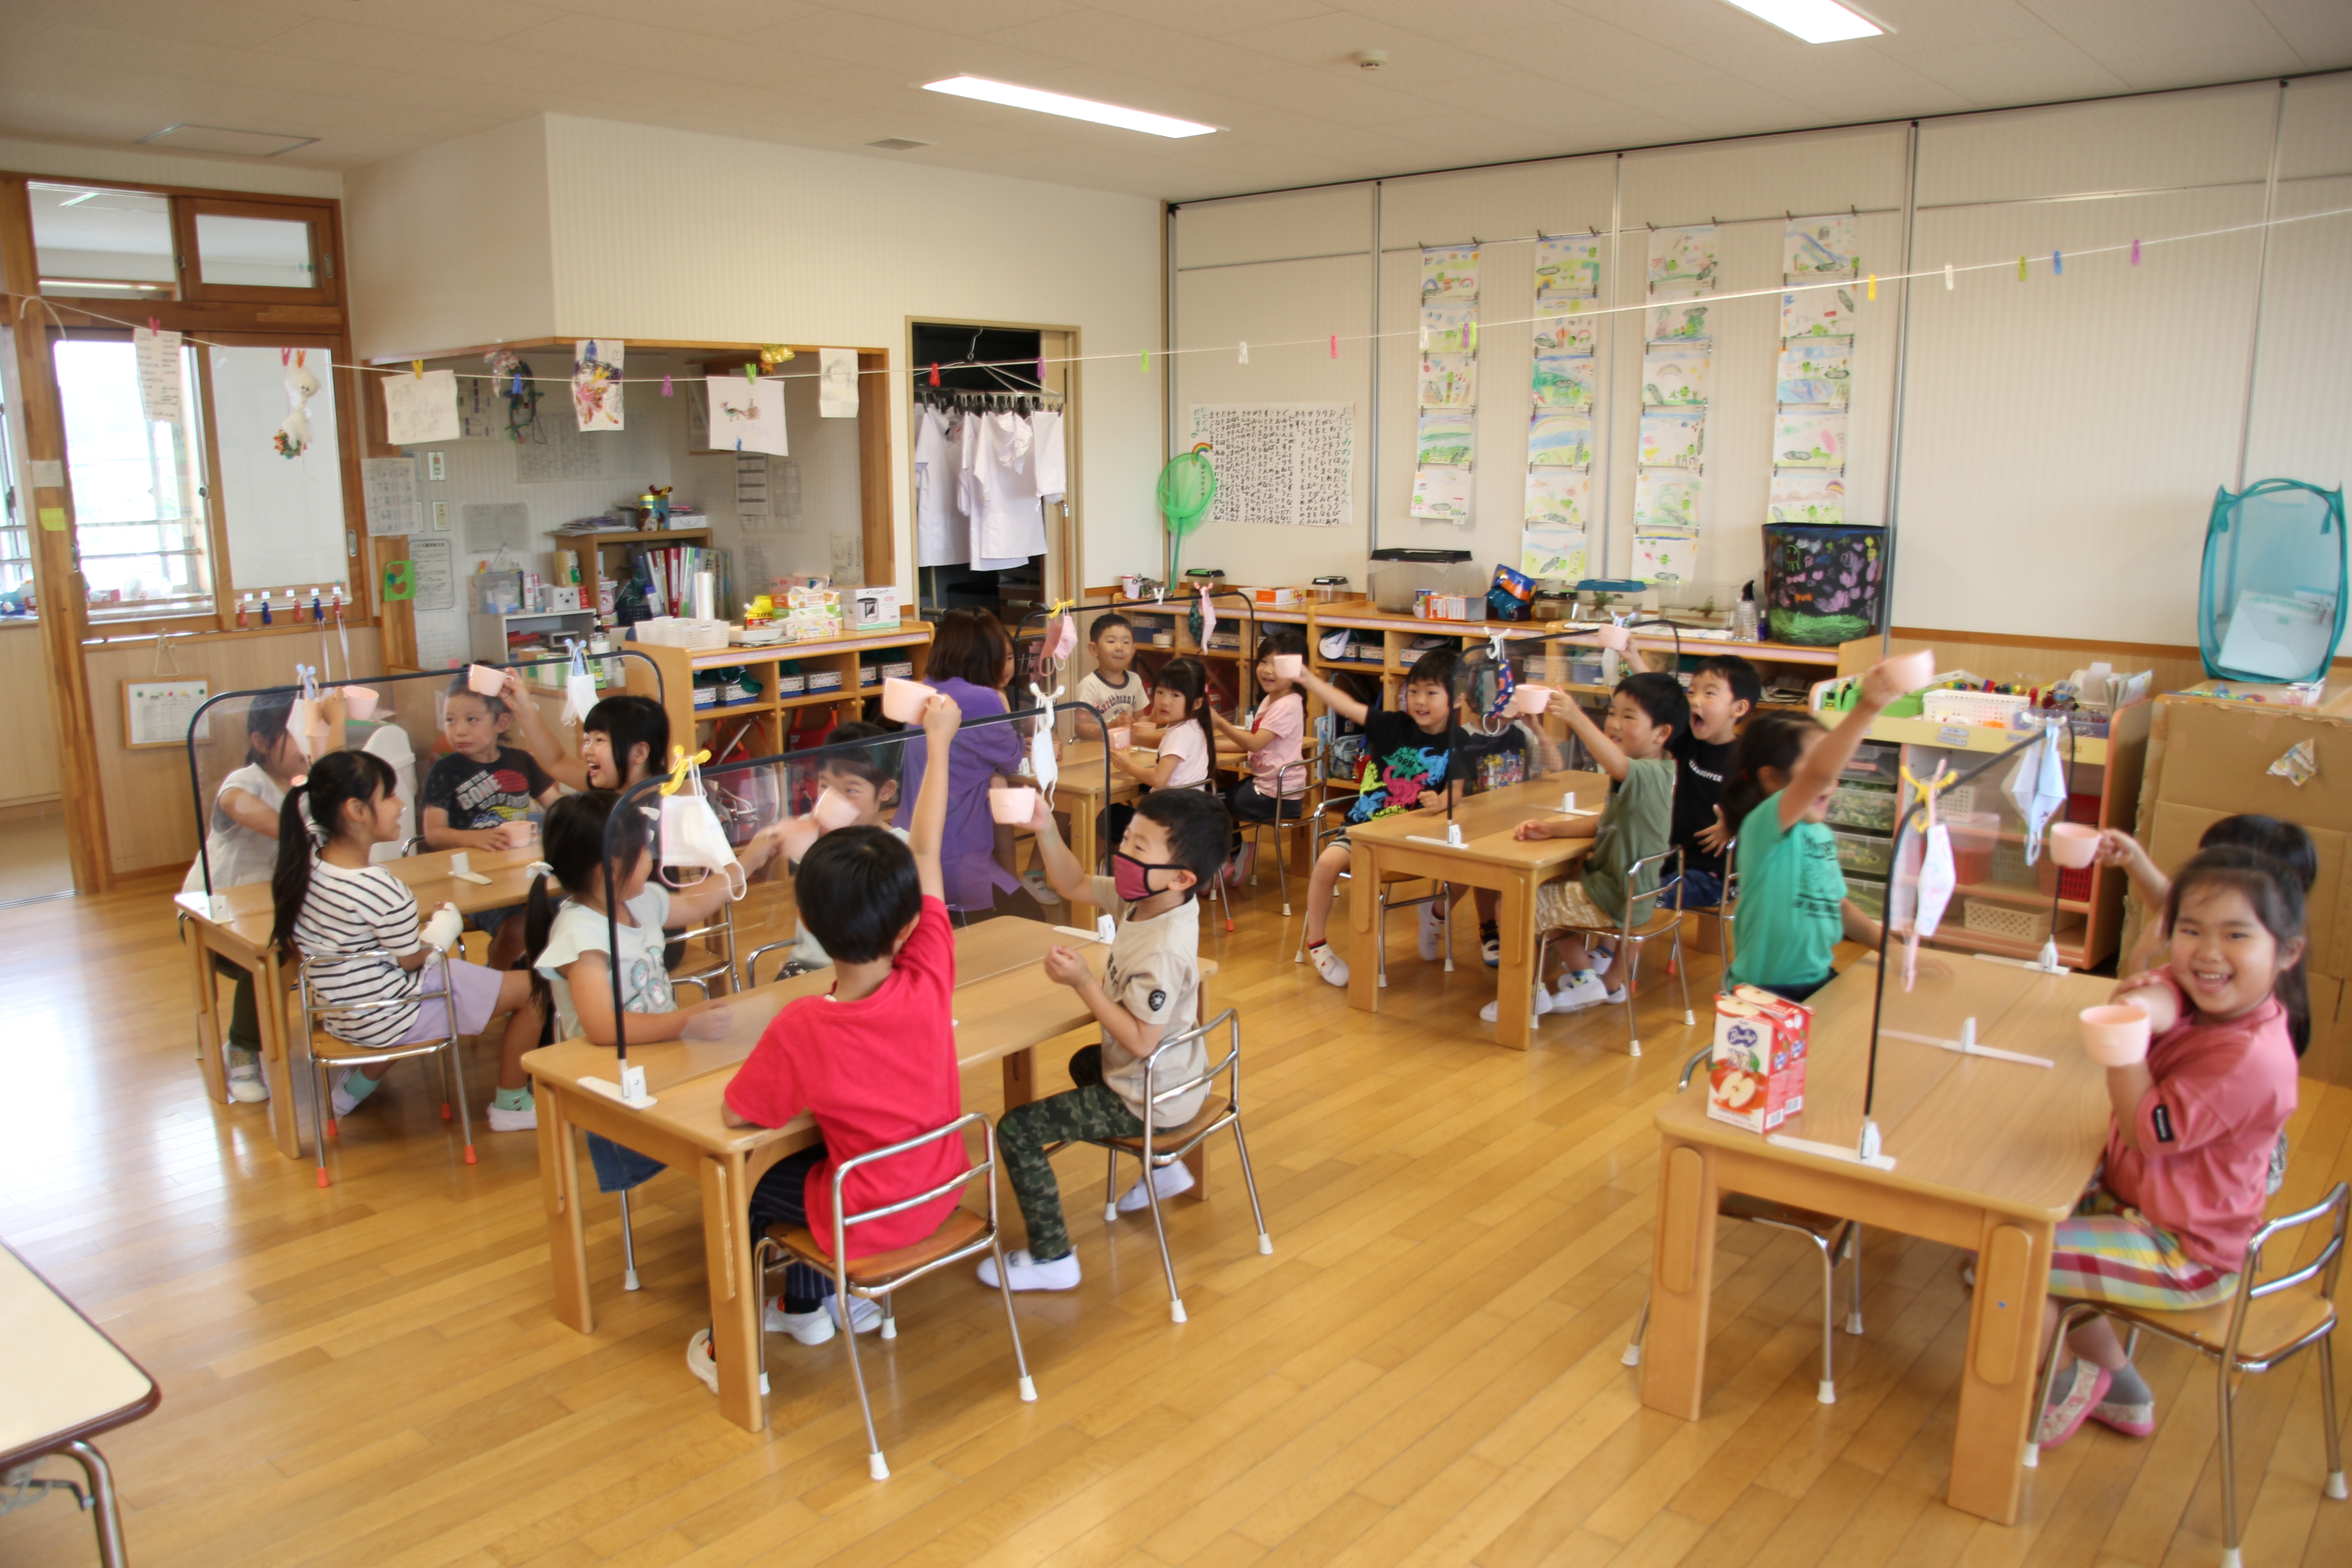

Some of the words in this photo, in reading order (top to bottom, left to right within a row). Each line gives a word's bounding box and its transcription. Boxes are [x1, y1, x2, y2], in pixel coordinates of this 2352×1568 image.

[1341, 407, 1352, 505] にじぐみのみなさんへ
[456, 774, 502, 811] BONE
